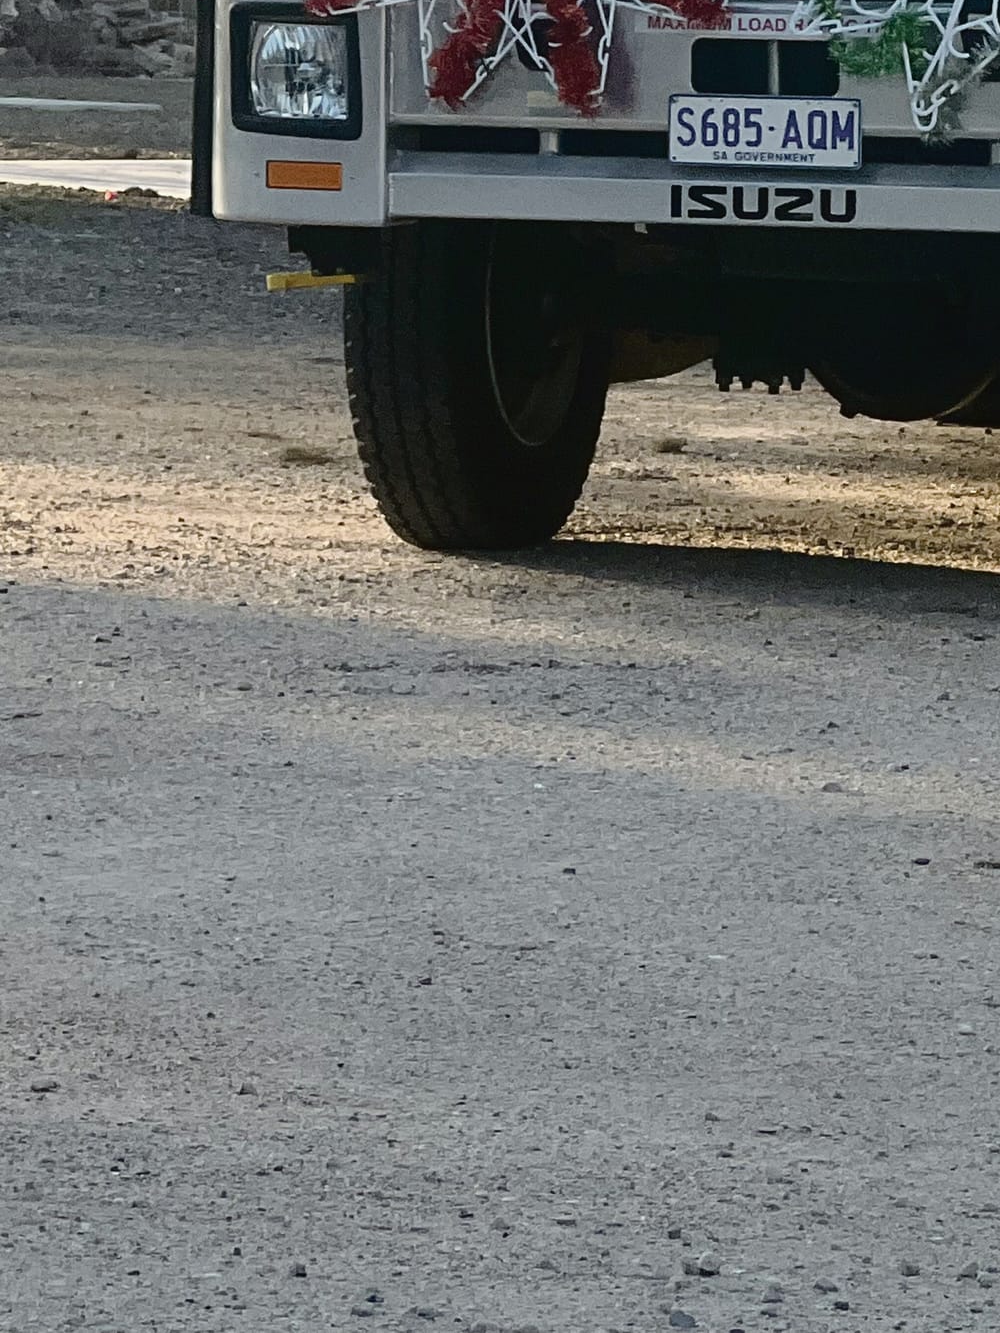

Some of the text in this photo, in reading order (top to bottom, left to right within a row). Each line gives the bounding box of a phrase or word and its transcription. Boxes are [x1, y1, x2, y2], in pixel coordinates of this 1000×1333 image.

[737, 18, 787, 33] LOAD
[713, 151, 817, 163] SA GOVERNMENT
[670, 184, 857, 224] ISUZU
